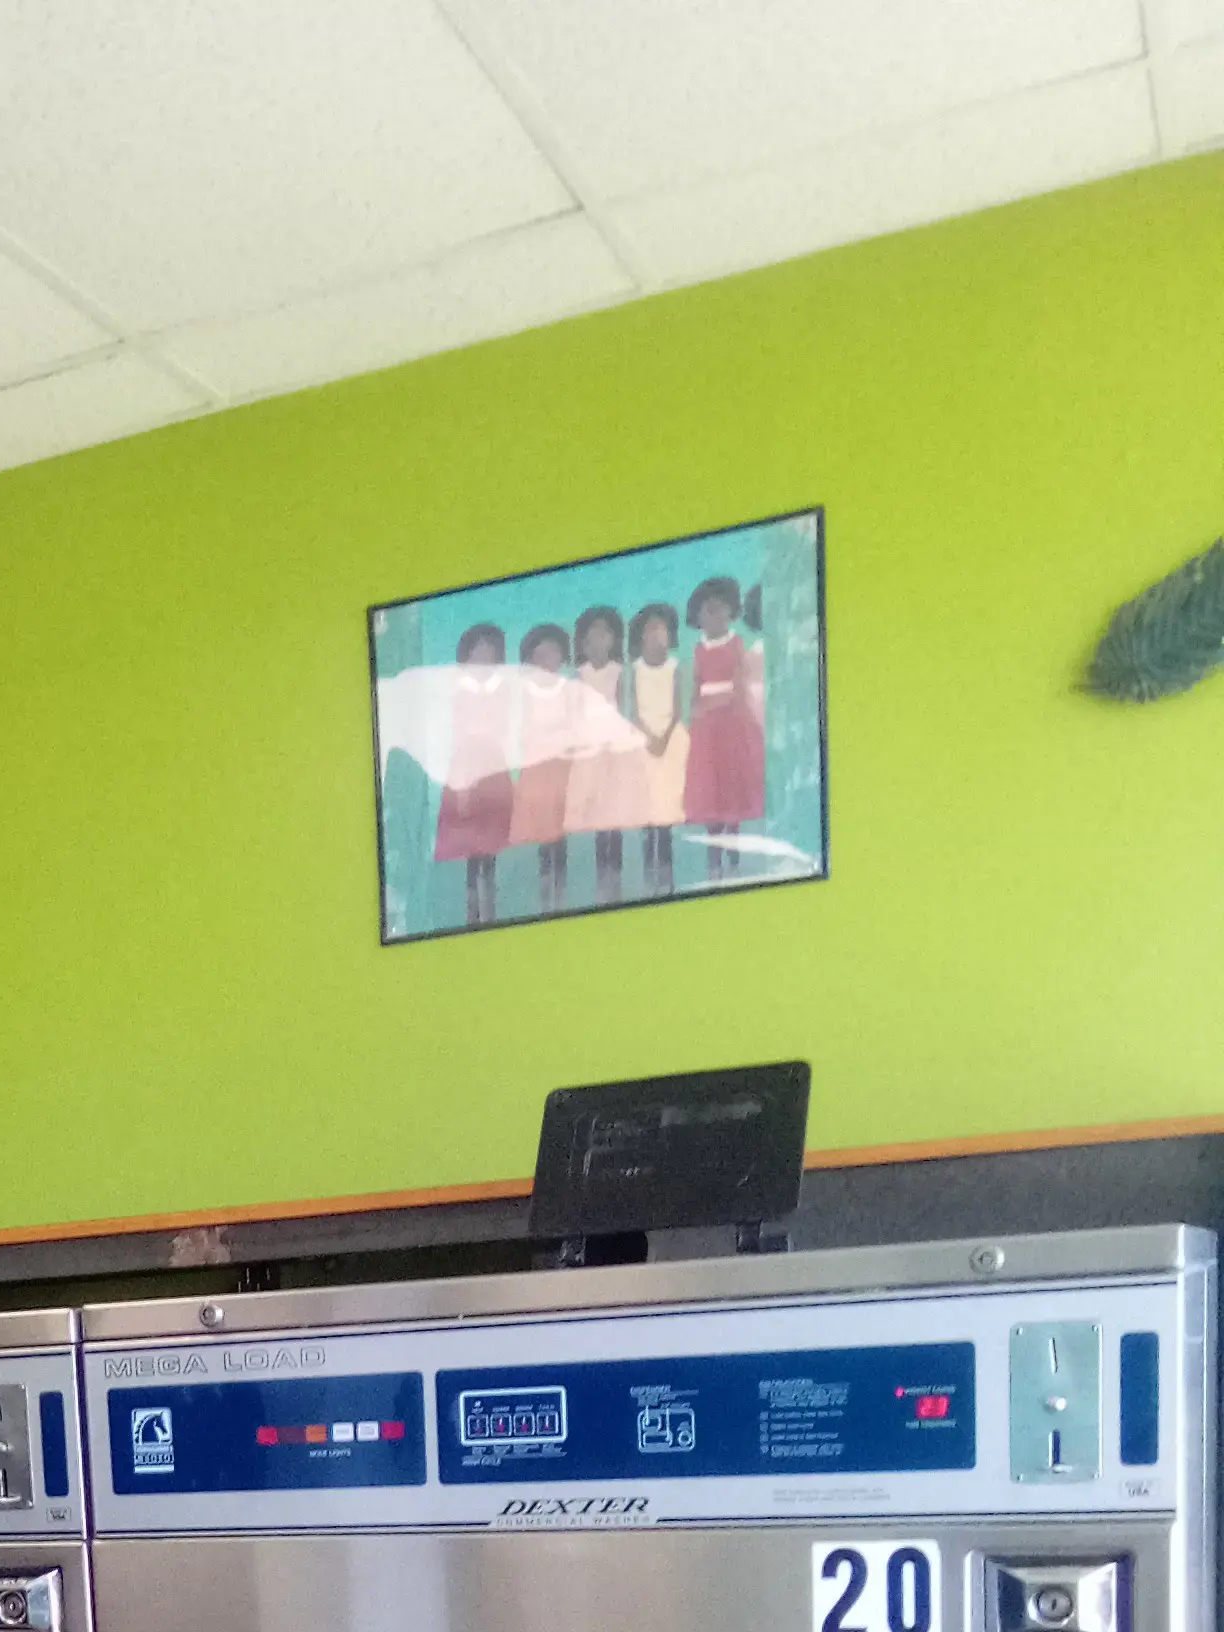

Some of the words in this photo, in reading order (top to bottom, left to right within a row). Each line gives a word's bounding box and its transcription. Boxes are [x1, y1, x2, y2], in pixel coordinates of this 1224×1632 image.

[104, 1352, 208, 1379] MEGA
[223, 1347, 326, 1372] LOAD
[497, 1497, 650, 1516] DEXTER
